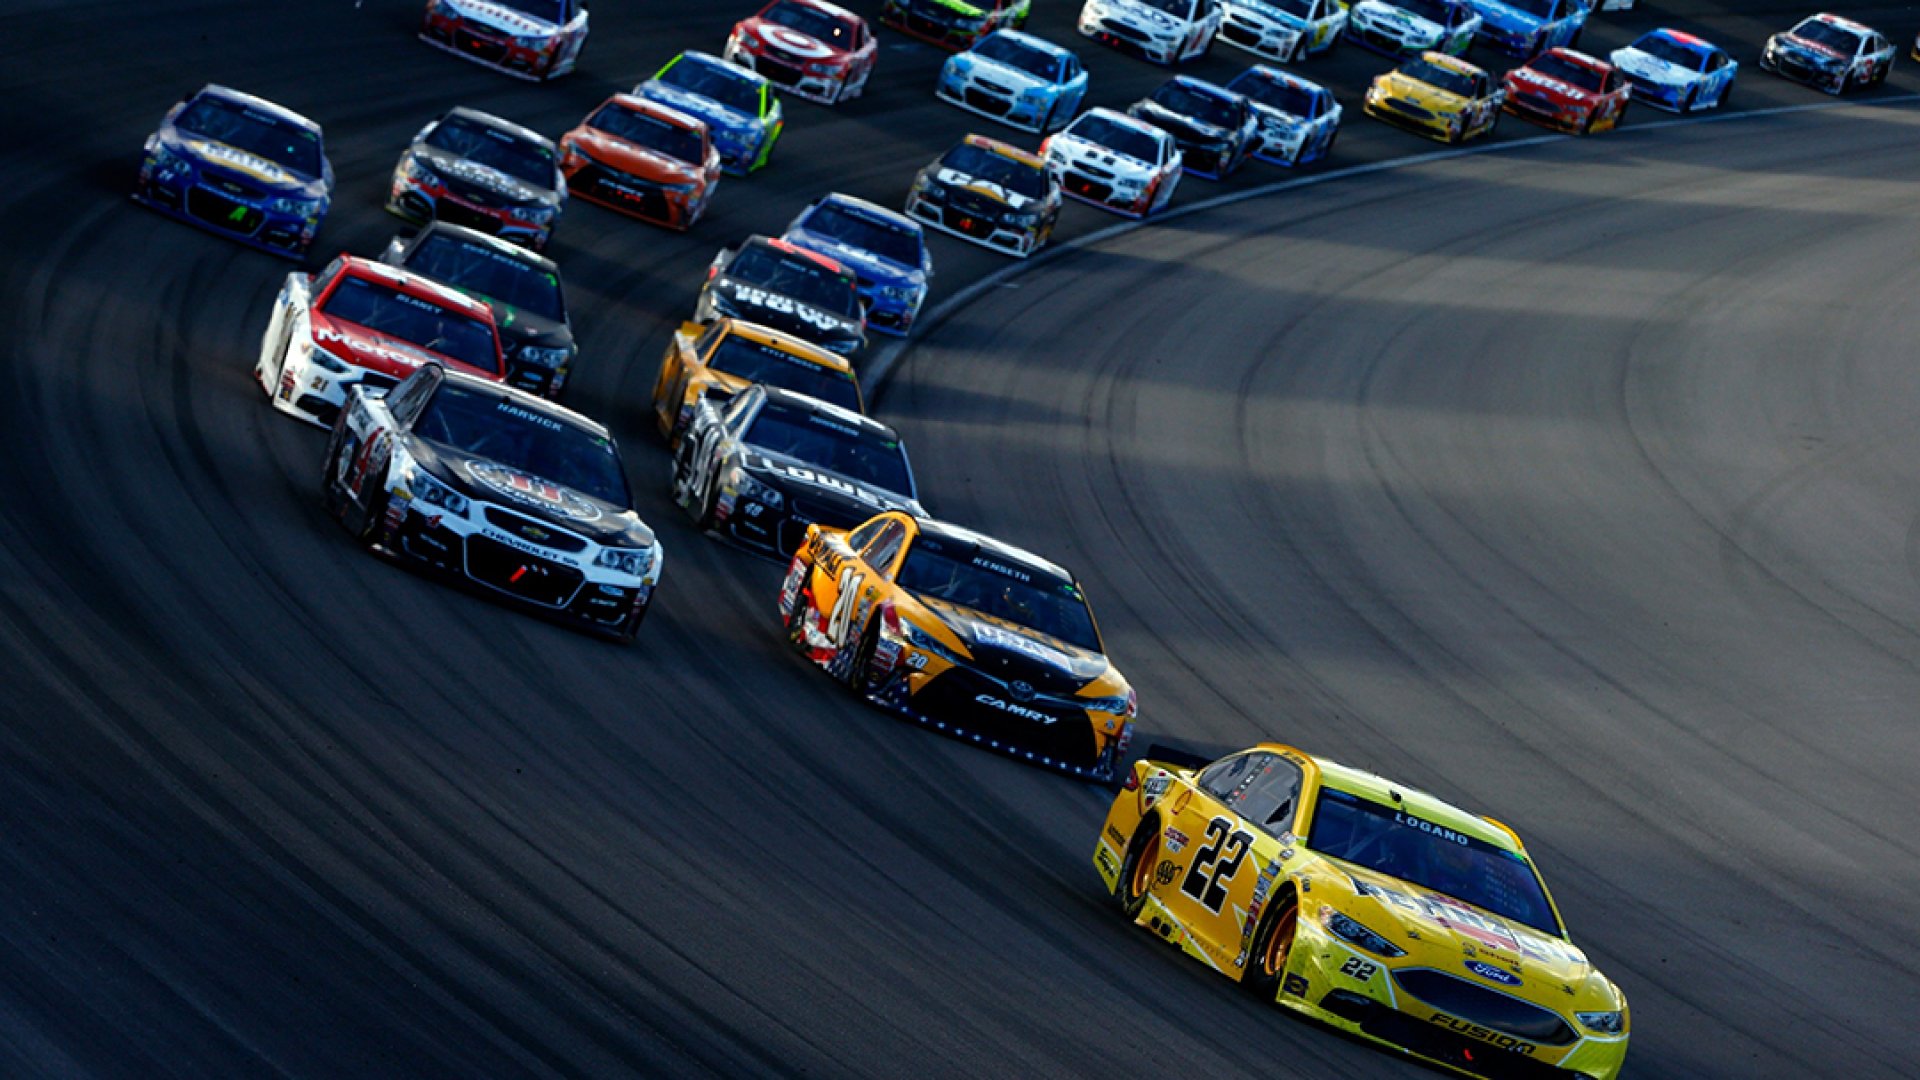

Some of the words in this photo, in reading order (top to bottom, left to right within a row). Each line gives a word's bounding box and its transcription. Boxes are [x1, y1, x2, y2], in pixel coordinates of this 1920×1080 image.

[496, 402, 563, 432] HARVICK
[972, 556, 1031, 583] KENSETH
[904, 650, 929, 669] 20
[974, 693, 1058, 725] CAMRY
[1394, 811, 1470, 847] LOGANO
[1181, 817, 1255, 914] 22
[1339, 956, 1377, 982] 22
[1472, 961, 1511, 983] Ford
[1428, 1012, 1538, 1054] FUSION
